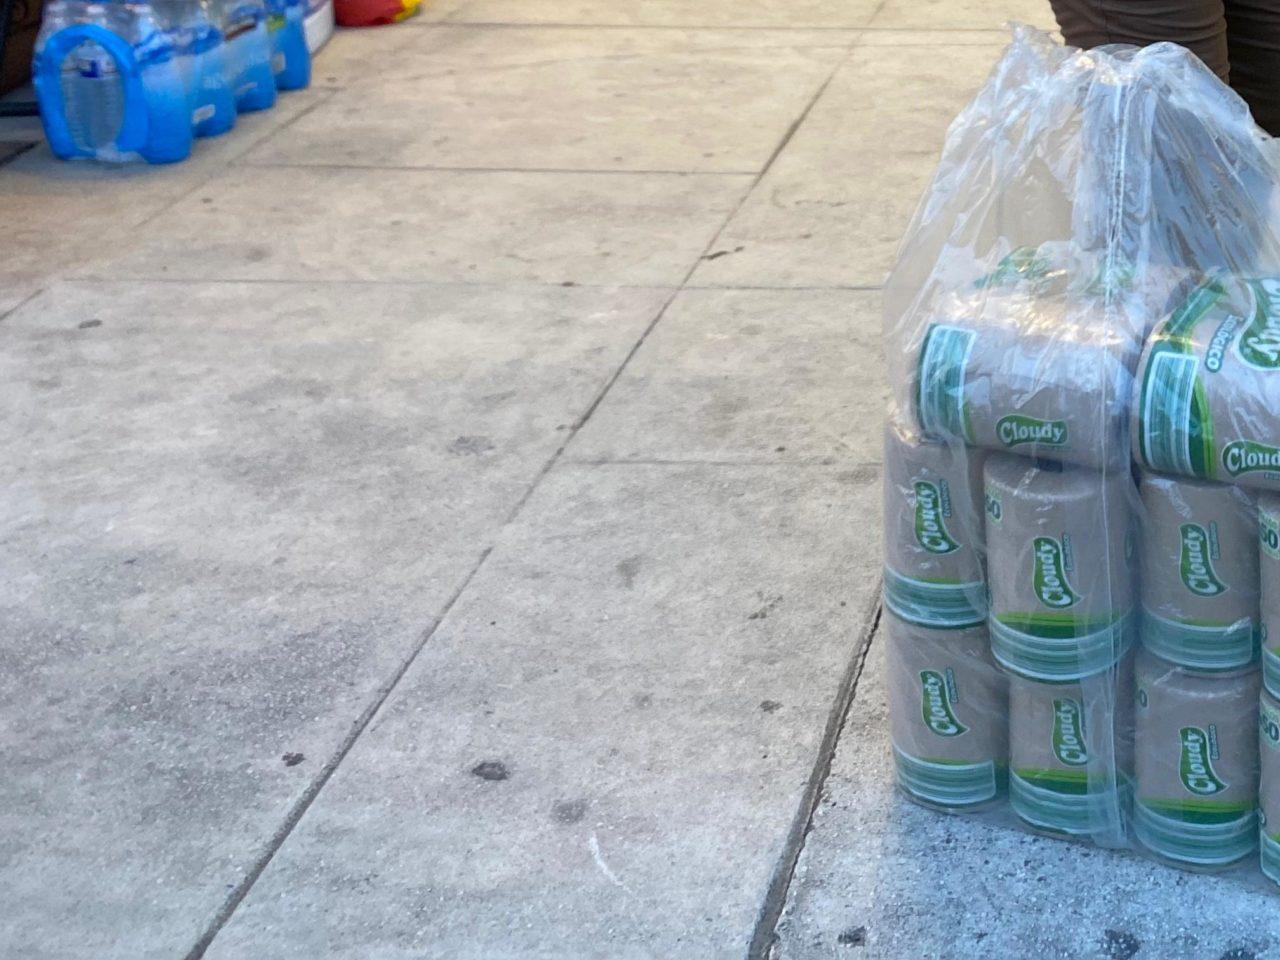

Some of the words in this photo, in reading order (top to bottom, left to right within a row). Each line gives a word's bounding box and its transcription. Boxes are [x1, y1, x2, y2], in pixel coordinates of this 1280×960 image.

[1001, 419, 1064, 444] Cloudy
[917, 485, 950, 551] Cloudy
[1037, 540, 1072, 606] Cloudy
[1183, 528, 1218, 594] Cloudy
[925, 674, 958, 734] Cloudy
[1057, 704, 1088, 763] Cloudy
[1184, 730, 1217, 792] Cloudy
